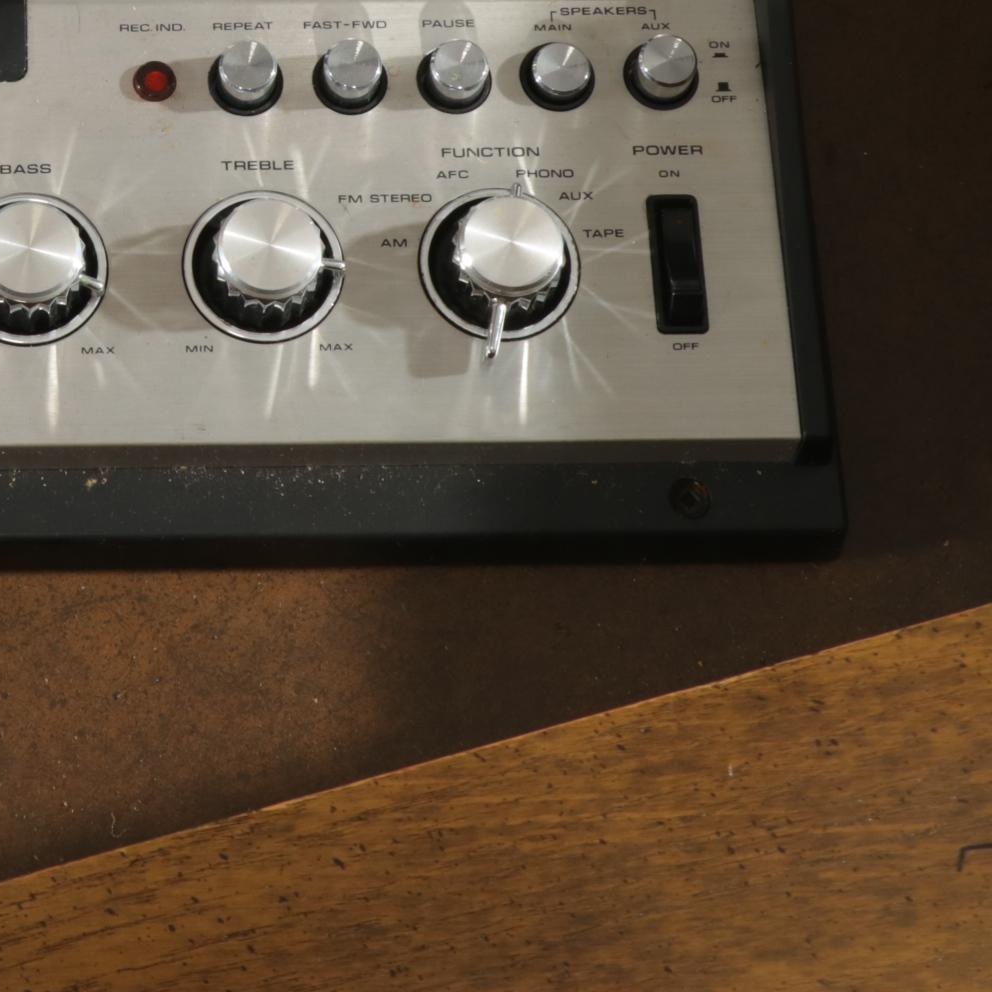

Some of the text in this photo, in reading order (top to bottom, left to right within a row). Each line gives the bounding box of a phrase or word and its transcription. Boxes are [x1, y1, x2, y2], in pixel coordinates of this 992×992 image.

[560, 7, 647, 16] SPEAKERS
[212, 21, 273, 31] REPEAT
[303, 20, 387, 30] FAST-FWD
[421, 19, 475, 29] PAUSE
[534, 23, 572, 32] MAIN
[708, 40, 731, 49] ON
[711, 95, 737, 104] OFF
[440, 146, 541, 159] FUNCTION
[632, 144, 704, 156] POWER
[0, 163, 52, 175] BASS
[221, 159, 294, 171] TREBLE
[436, 169, 470, 180] AFC
[515, 168, 575, 179] PHONO
[658, 169, 681, 178] ON
[337, 193, 433, 204] FM STEREO
[558, 191, 594, 201] AUX
[582, 228, 625, 239] TAPE
[380, 238, 408, 248] AM
[80, 346, 115, 355] MAX
[185, 344, 214, 353] MIN
[319, 343, 353, 352] MAX
[672, 342, 699, 351] OFF
